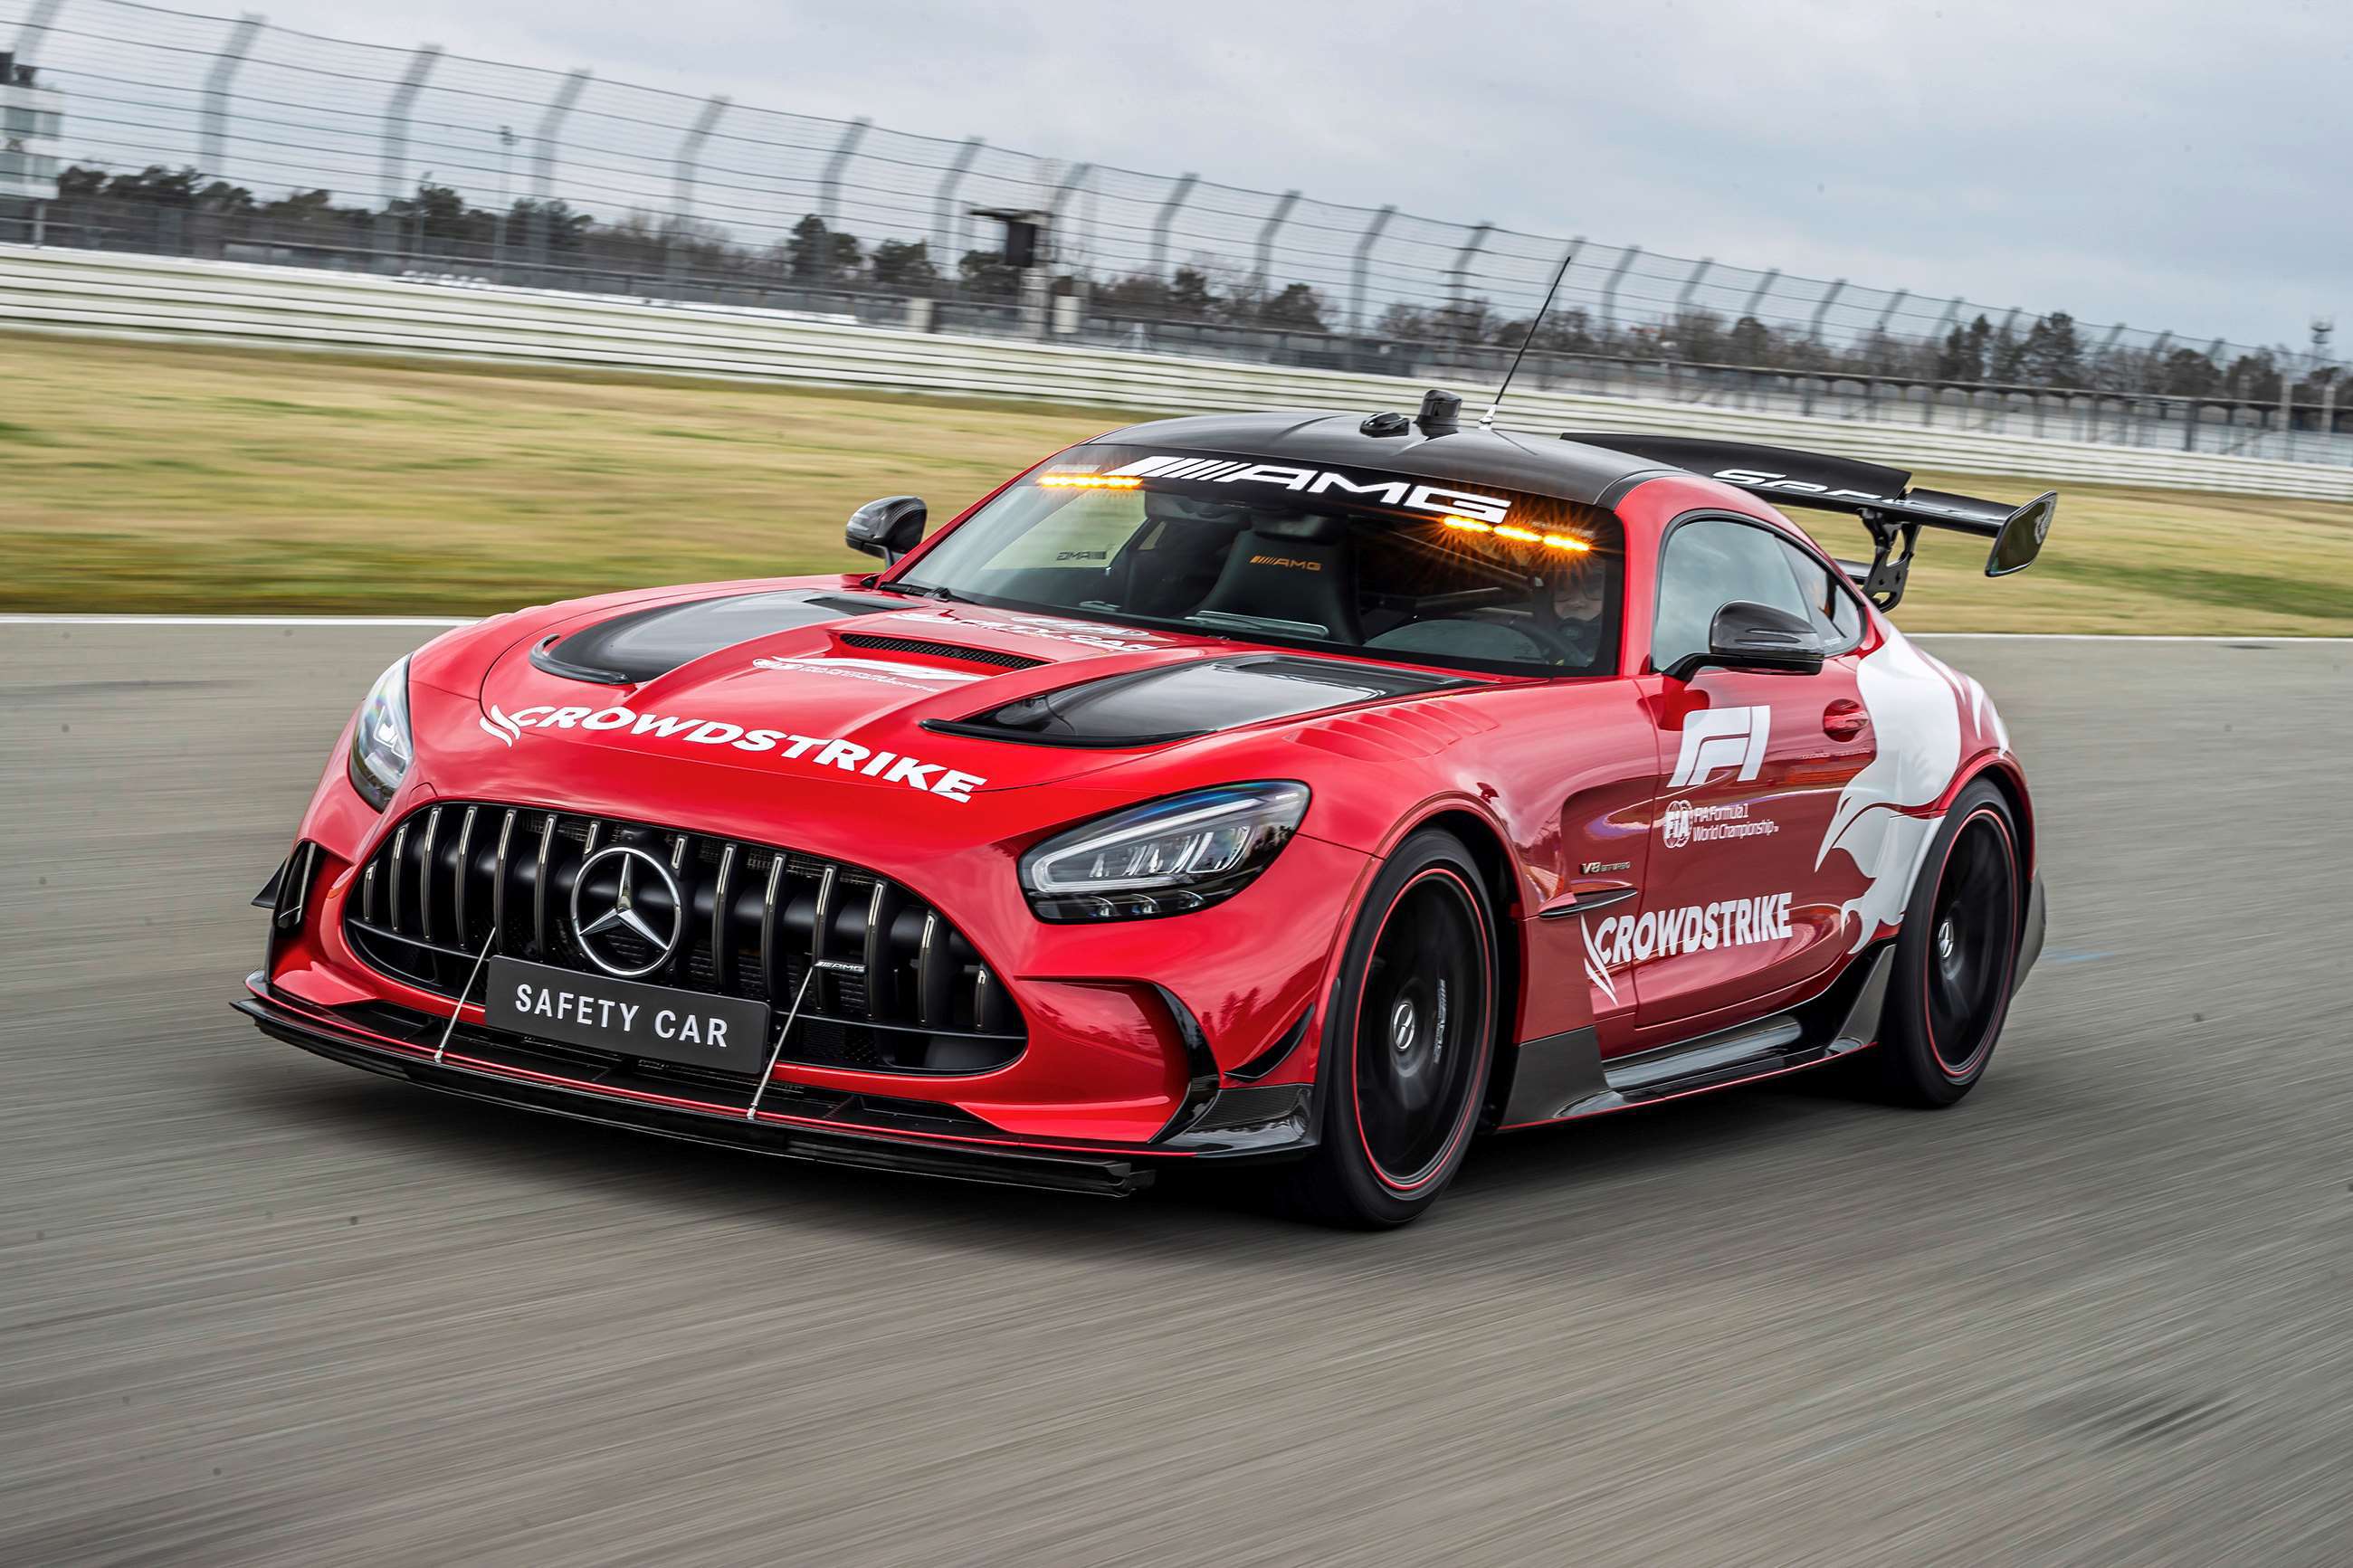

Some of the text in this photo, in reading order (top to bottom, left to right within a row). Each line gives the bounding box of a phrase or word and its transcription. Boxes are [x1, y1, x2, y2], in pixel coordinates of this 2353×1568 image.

[1213, 464, 1510, 524] AMG
[1273, 557, 1323, 572] AMG
[510, 705, 987, 803] CROWDSTRIKE
[1709, 804, 1742, 822] Formula
[1692, 825, 1719, 841] World
[1582, 861, 1601, 874] V8
[1594, 892, 1793, 964] CROWDSTRIKE
[514, 984, 728, 1048] SAFETY CAR
